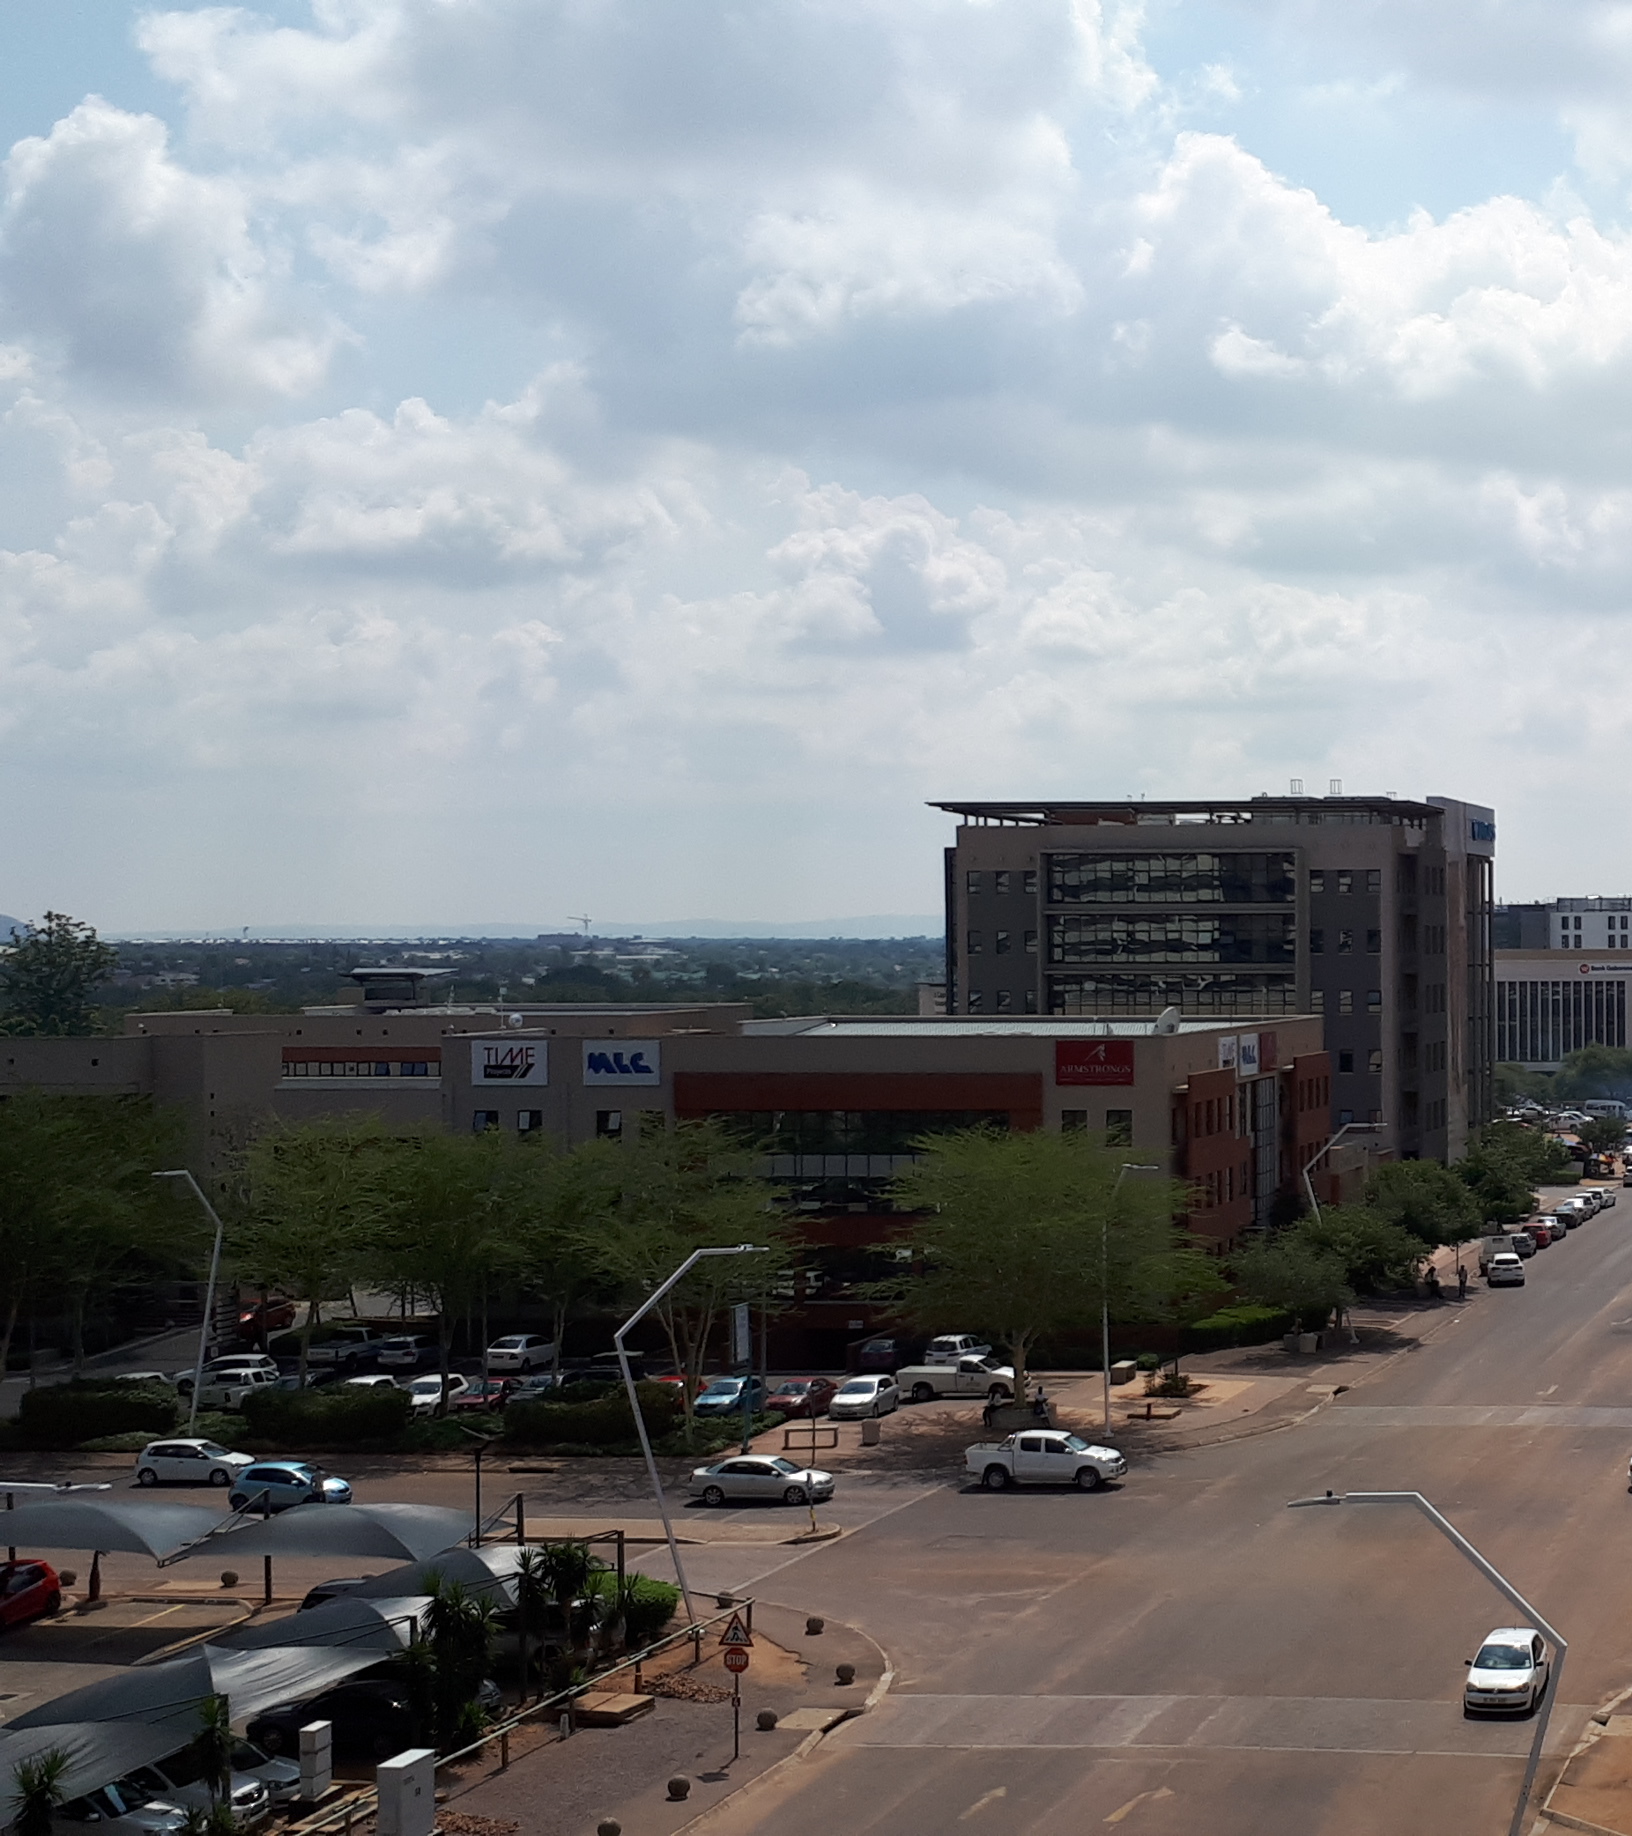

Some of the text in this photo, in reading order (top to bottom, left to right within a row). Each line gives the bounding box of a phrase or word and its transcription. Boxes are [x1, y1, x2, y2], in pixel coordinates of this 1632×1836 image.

[483, 1047, 535, 1064] TIME
[587, 1052, 655, 1074] MLC
[1061, 1064, 1132, 1073] ARMSTRONGS
[726, 1654, 747, 1665] STOP
